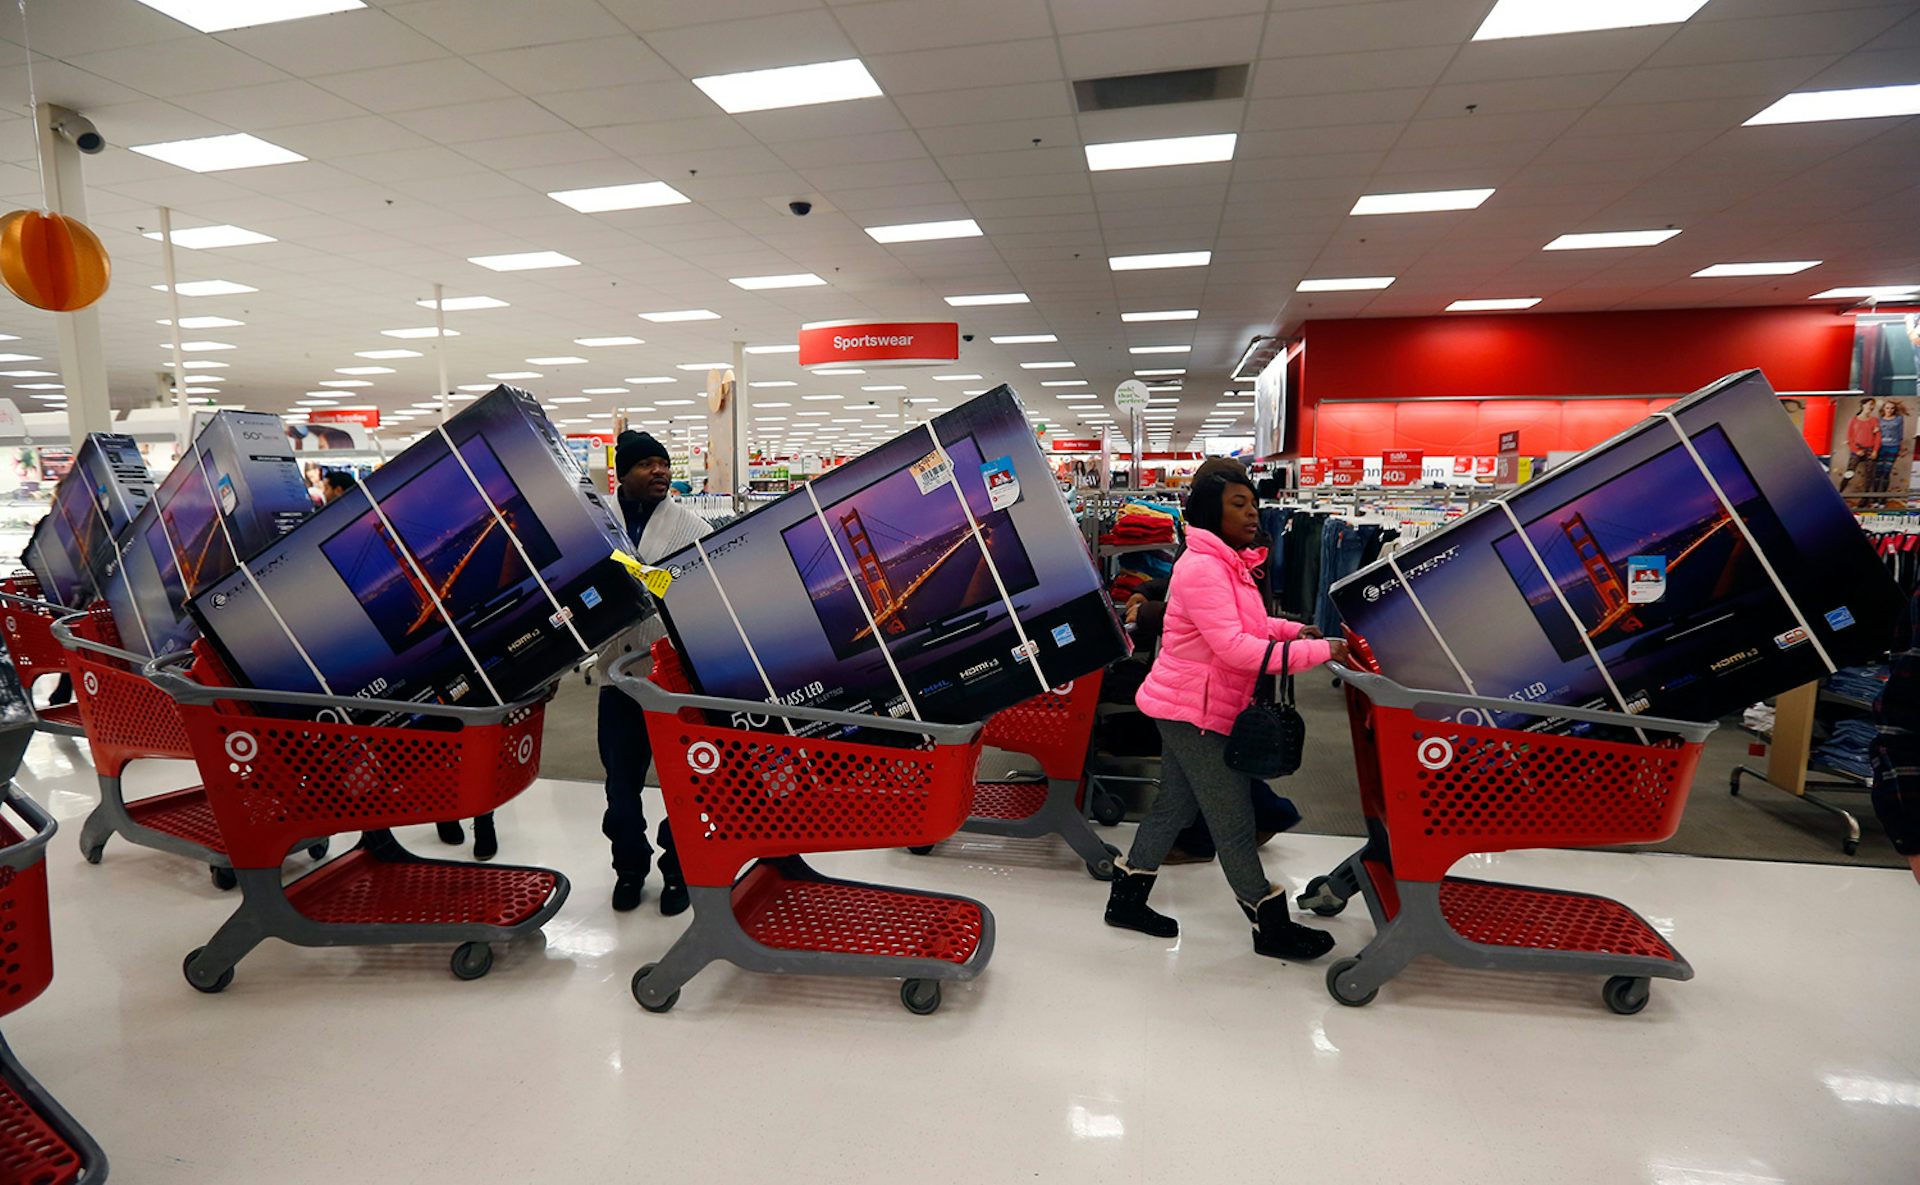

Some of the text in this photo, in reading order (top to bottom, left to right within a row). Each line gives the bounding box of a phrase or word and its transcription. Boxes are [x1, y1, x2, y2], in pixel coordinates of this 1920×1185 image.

[833, 335, 914, 350] Sportswear
[1776, 628, 1807, 648] LED
[368, 677, 388, 695] LED
[804, 680, 824, 698] LED
[1524, 681, 1547, 700] LED
[1627, 698, 1650, 714] 080
